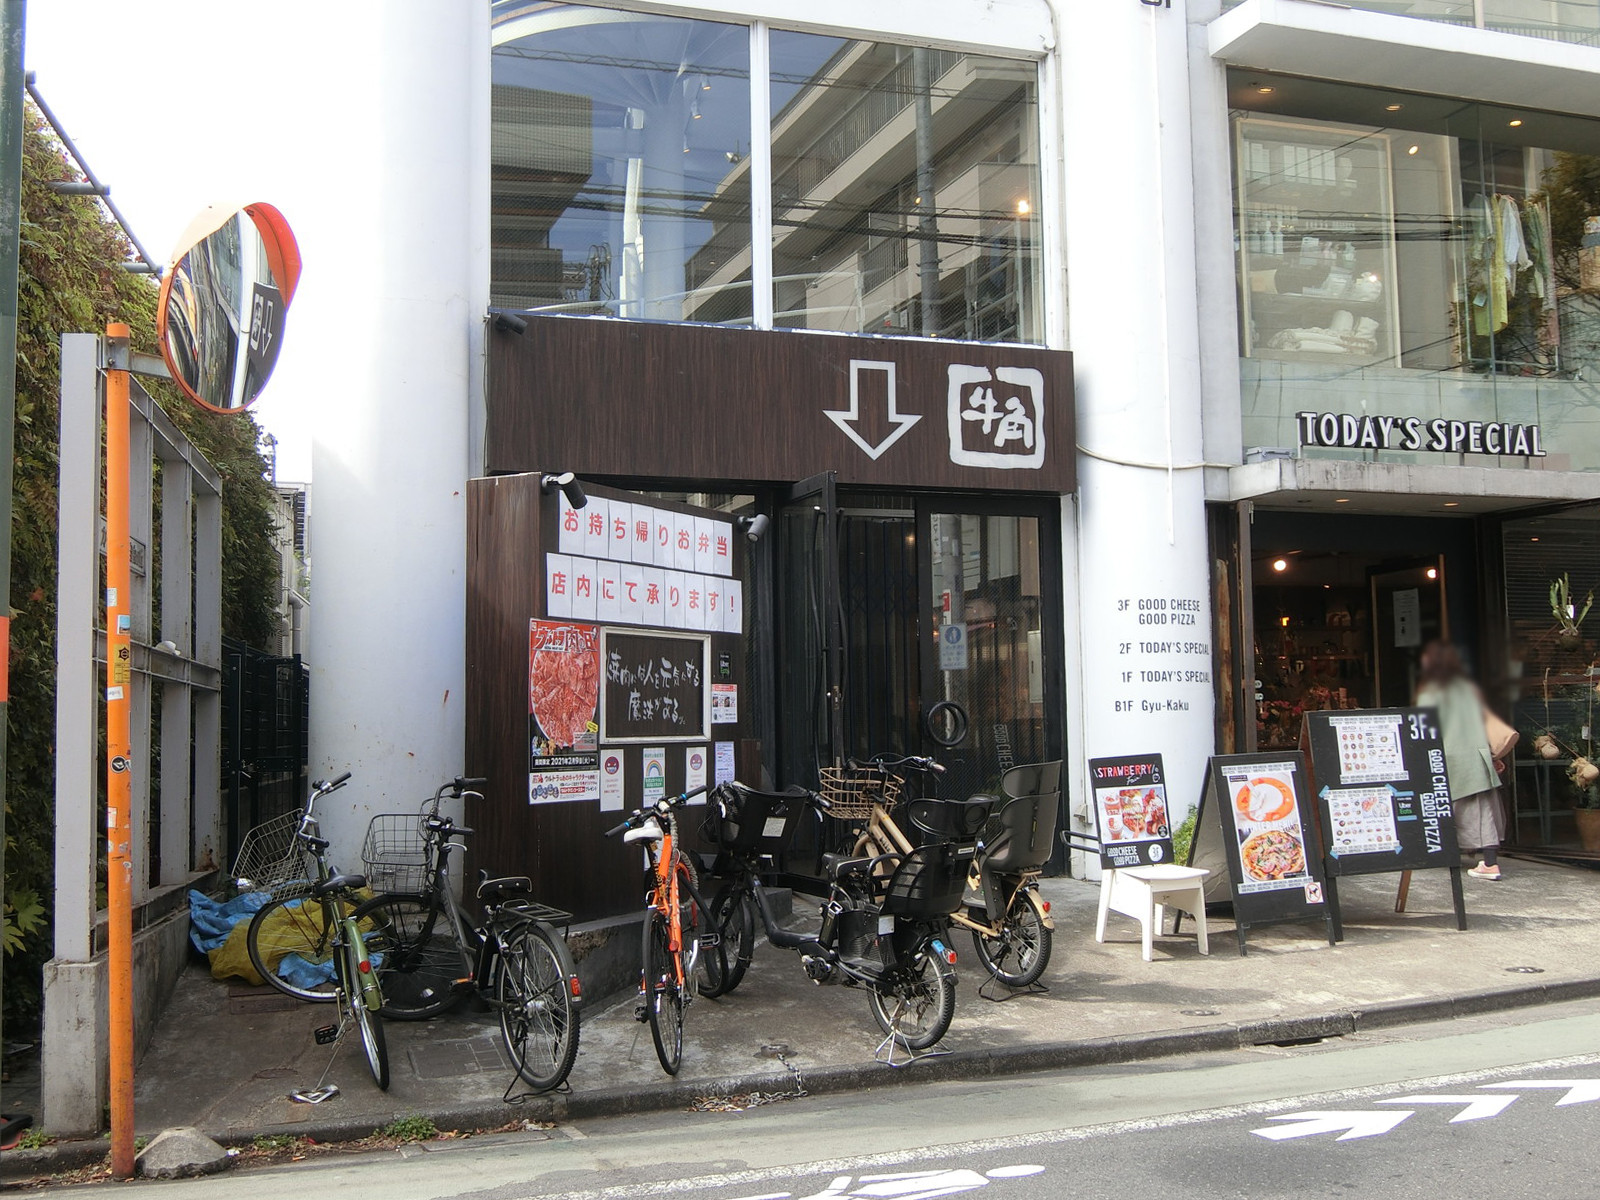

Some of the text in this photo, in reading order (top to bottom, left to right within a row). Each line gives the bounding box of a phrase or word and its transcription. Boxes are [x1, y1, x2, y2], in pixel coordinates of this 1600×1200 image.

[961, 386, 1034, 449] 牛角
[1297, 411, 1547, 457] TODAY'S SPECIAL
[564, 508, 728, 557] お持ち帰りお弁当
[551, 571, 735, 613] 店内にて承ります！
[1117, 599, 1200, 611] 3F GOOD CHEESE
[1139, 613, 1196, 625] GOOD PIZZA
[1119, 642, 1210, 655] 2F TODAY'S SPECIAL
[1121, 671, 1210, 683] 1F TODAY'S SPECIAL
[1115, 699, 1190, 714] B1F Gyu-Kaku
[1408, 714, 1427, 740] 3F
[1097, 764, 1152, 778] STRAWBERRY
[1428, 749, 1452, 818] GOOD CHEESE
[1420, 792, 1442, 854] GOOD PIZZA
